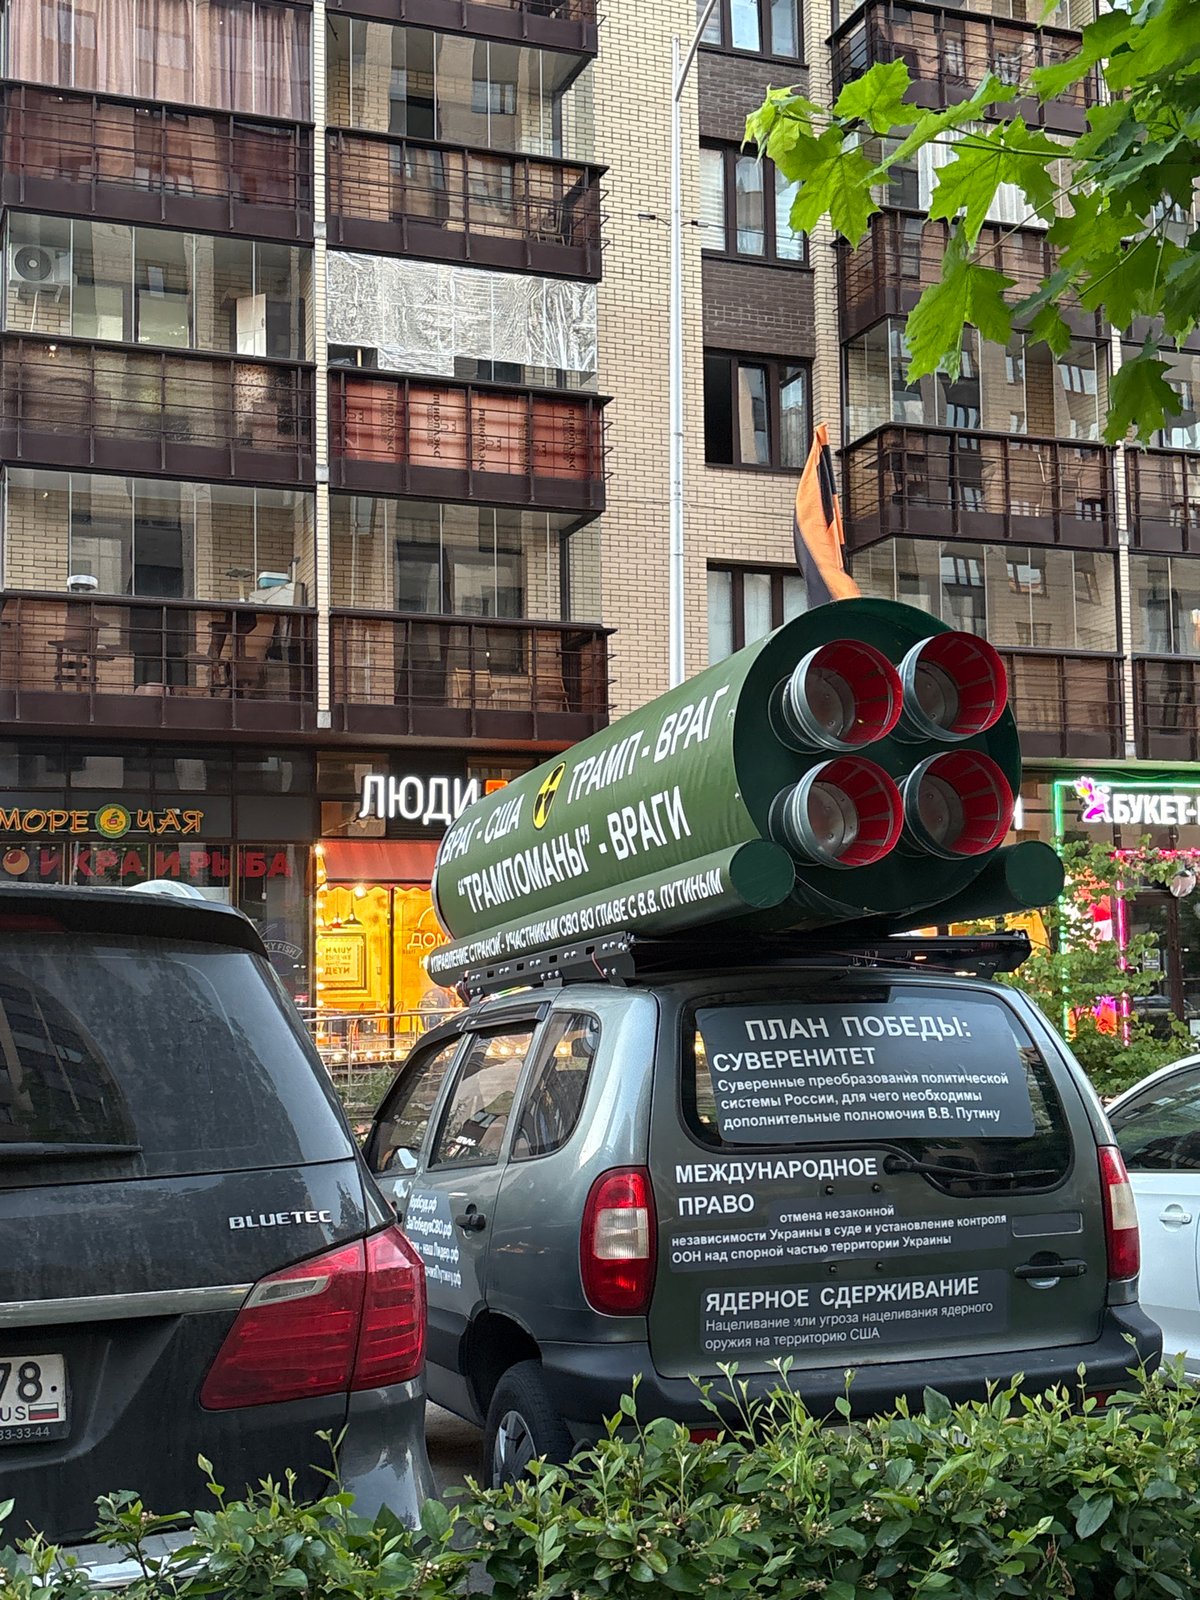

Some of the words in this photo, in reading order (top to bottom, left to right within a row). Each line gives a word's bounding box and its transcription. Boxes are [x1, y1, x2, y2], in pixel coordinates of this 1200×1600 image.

[439, 816, 482, 866] ВРАГ
[484, 793, 526, 845] США
[567, 729, 645, 805] ТРАМП
[653, 684, 730, 764] ВРАГ
[358, 775, 478, 827] ЛЮДИ
[1112, 793, 1200, 825] БУКЕТ-
[0, 807, 90, 834] МОРЕ
[136, 808, 205, 835] ЧАЯ
[607, 785, 692, 861] ВРАГИ
[39, 850, 145, 877] ИКРА
[155, 850, 181, 877] И
[189, 850, 292, 878] РЫБА
[469, 931, 502, 963] СТРАНОЙ
[505, 917, 560, 952] УЧАСТНИКАМ
[559, 912, 579, 937] СВО
[580, 907, 595, 931] ВО
[595, 896, 628, 928] ГЛАВЕ
[627, 894, 637, 919] С
[638, 889, 661, 916] В.В.
[660, 867, 724, 910] ПУТИНЫМ
[277, 943, 297, 956] FISH
[744, 1017, 830, 1041] ПЛАН
[841, 1016, 972, 1042] ПОБЕДЫ:
[713, 1046, 876, 1073] СУВЕРЕНИТЕТ
[717, 1077, 806, 1094] Суверенные
[808, 1072, 919, 1089] преобразования
[921, 1072, 1009, 1086] политической
[721, 1096, 782, 1110] системы
[784, 1092, 839, 1106] России,
[842, 1093, 867, 1105] для
[869, 1091, 900, 1102] чего
[902, 1088, 983, 1104] необходимы
[723, 1110, 841, 1132] дополнительные
[844, 1108, 926, 1122] полномочия
[927, 1106, 954, 1120] В.В.
[956, 1106, 1001, 1123] Путину
[675, 1157, 878, 1185] МЕЖДУНАРОДНОЕ
[678, 1192, 755, 1217] ПРАВО
[779, 1209, 823, 1224] отмена
[825, 1204, 895, 1221] незаконной
[229, 1209, 332, 1230] BLUETEC
[671, 1230, 767, 1248] независимости
[769, 1226, 823, 1243] Украины
[824, 1227, 832, 1237] в
[833, 1223, 862, 1237] суде
[864, 1222, 872, 1233] и
[875, 1217, 955, 1236] установление
[956, 1213, 1007, 1229] контроля
[672, 1250, 702, 1264] ООН
[704, 1251, 729, 1264] над
[730, 1244, 785, 1261] спорной
[786, 1241, 829, 1256] частью
[830, 1238, 900, 1254] территории
[902, 1234, 953, 1249] Украины
[705, 1288, 809, 1316] ЯДЕРНОЕ
[820, 1276, 979, 1309] СДЕРЖИВАНИЕ
[705, 1317, 790, 1333] Нацеливание
[793, 1316, 816, 1327] или
[819, 1312, 859, 1328] угроза
[862, 1306, 939, 1324] нацеливания
[941, 1302, 994, 1318] ядерного
[705, 1336, 752, 1352] оружия
[755, 1335, 771, 1347] на
[773, 1330, 847, 1348] территорию
[850, 1326, 881, 1341] США
[0, 1406, 26, 1421] US
